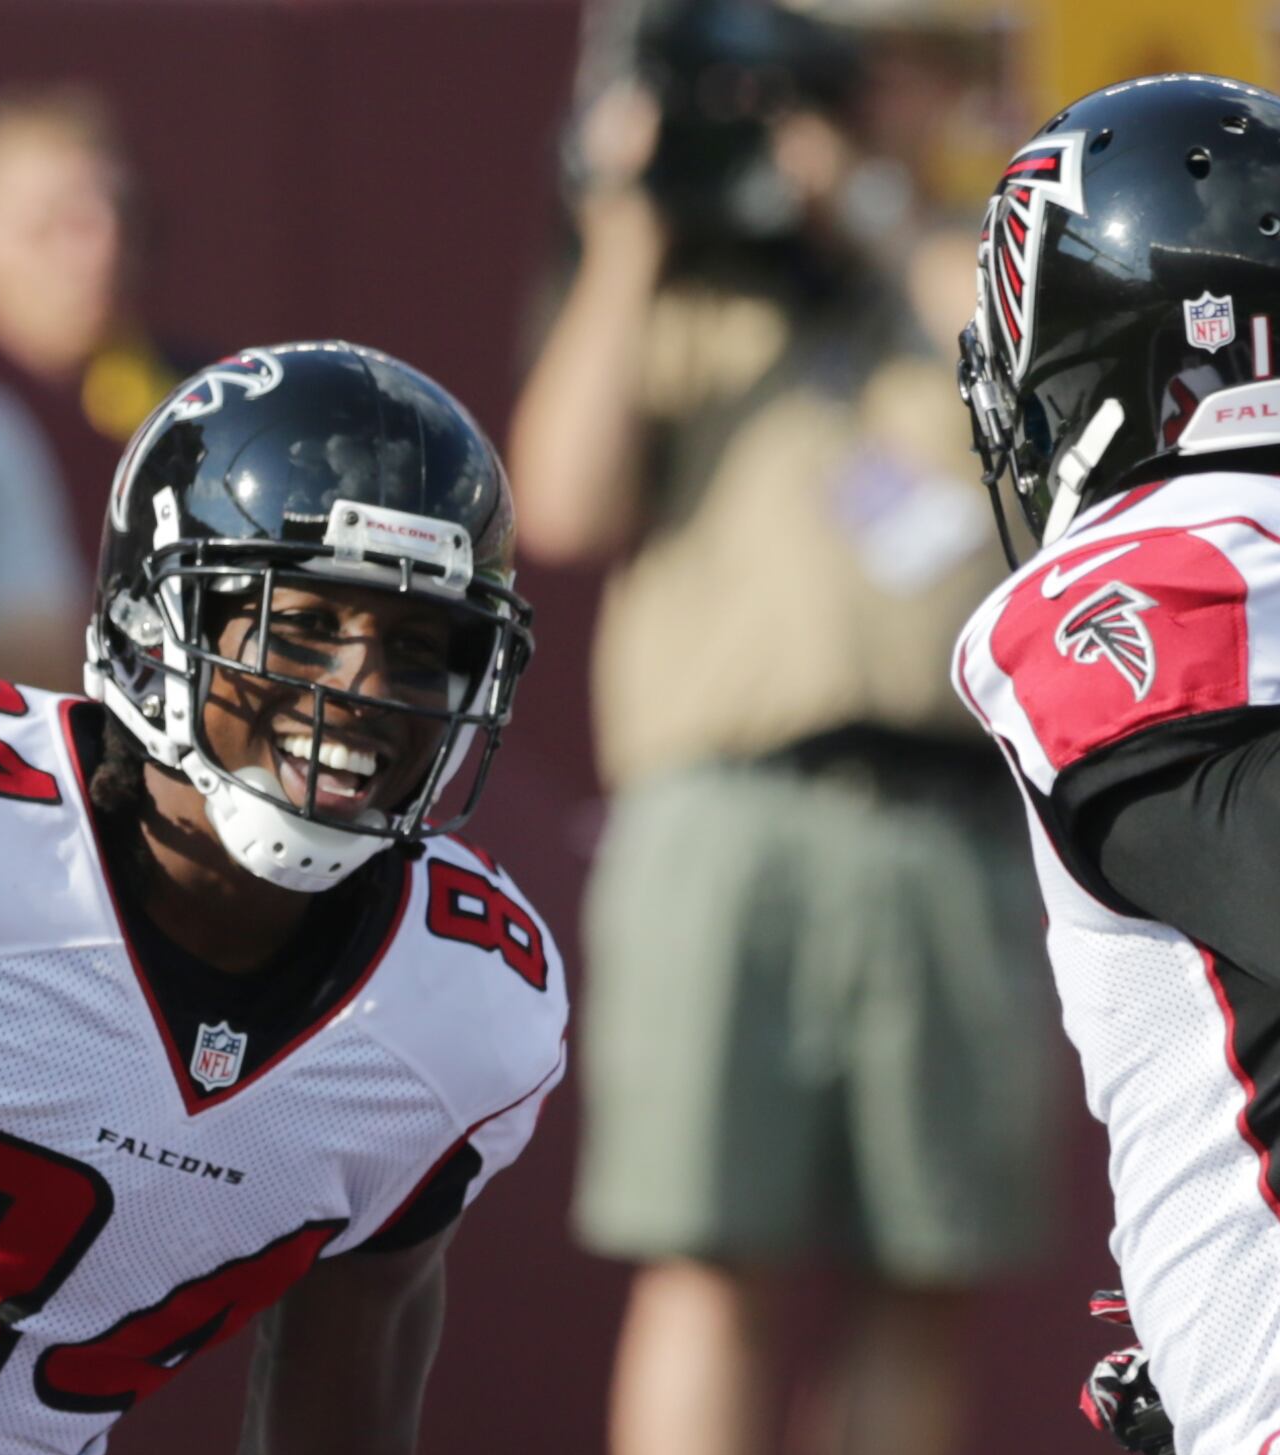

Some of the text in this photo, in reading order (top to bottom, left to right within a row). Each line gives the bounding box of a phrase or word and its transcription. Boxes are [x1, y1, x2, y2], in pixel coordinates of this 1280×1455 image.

[1194, 320, 1230, 343] NFL
[366, 519, 438, 543] FALCONS
[425, 834, 549, 994] 8
[197, 1049, 233, 1080] NFL
[97, 1127, 247, 1186] FALCONS
